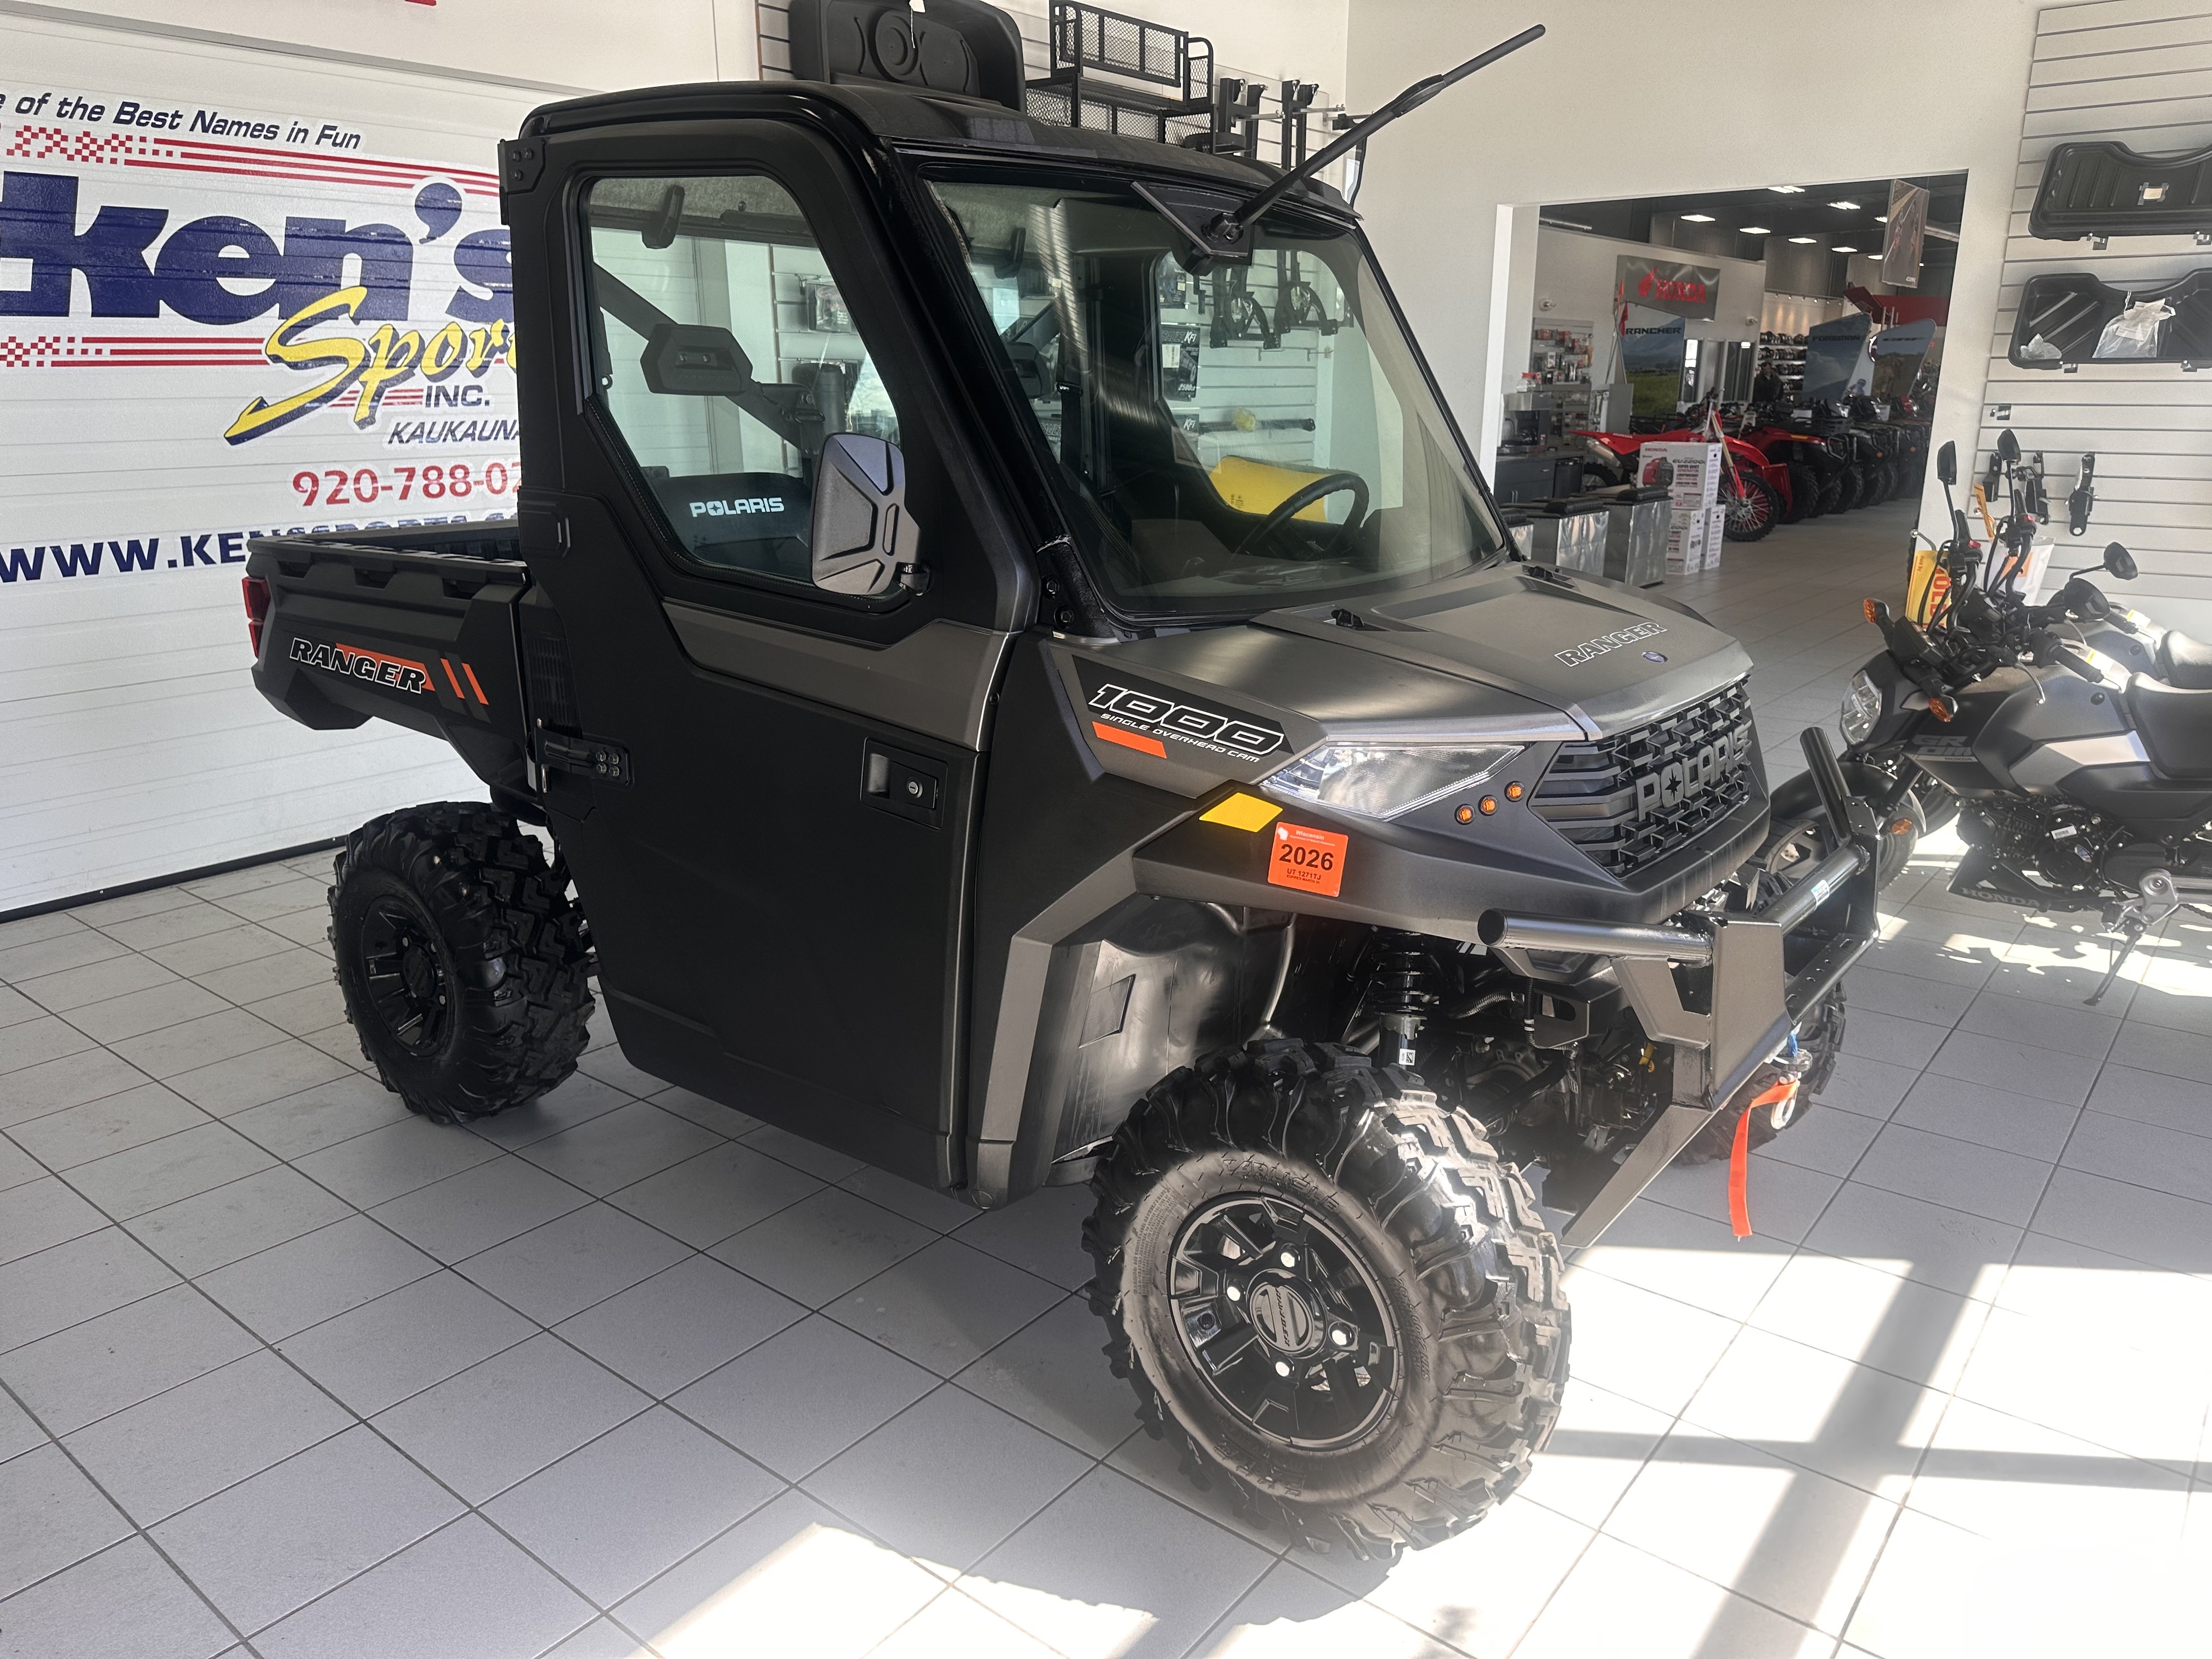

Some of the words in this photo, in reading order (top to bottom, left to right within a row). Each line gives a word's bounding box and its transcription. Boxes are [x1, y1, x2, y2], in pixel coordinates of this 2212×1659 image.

[15, 93, 52, 115] of
[56, 96, 105, 121] the
[112, 101, 184, 130] Best
[189, 110, 280, 140] Names
[286, 121, 309, 144] in
[315, 125, 361, 149] Fun
[1655, 279, 1706, 303] HONDA
[425, 385, 490, 408] INC.
[388, 419, 520, 445] KAUKAUN
[689, 496, 785, 518] POLARIS
[1554, 622, 1668, 667] RANGER
[290, 637, 426, 694] RANGER
[1088, 684, 1284, 755] 1000
[1099, 713, 1150, 731] SINGLE
[1152, 728, 1226, 754] OVERHEAD
[1227, 749, 1261, 763] CAM
[1635, 716, 1752, 821] POLARIS
[1295, 829, 1325, 840] Wisconsin
[1279, 843, 1334, 871] 2026
[1298, 870, 1322, 881] 1271TJ
[1960, 887, 2040, 906] HONDA
